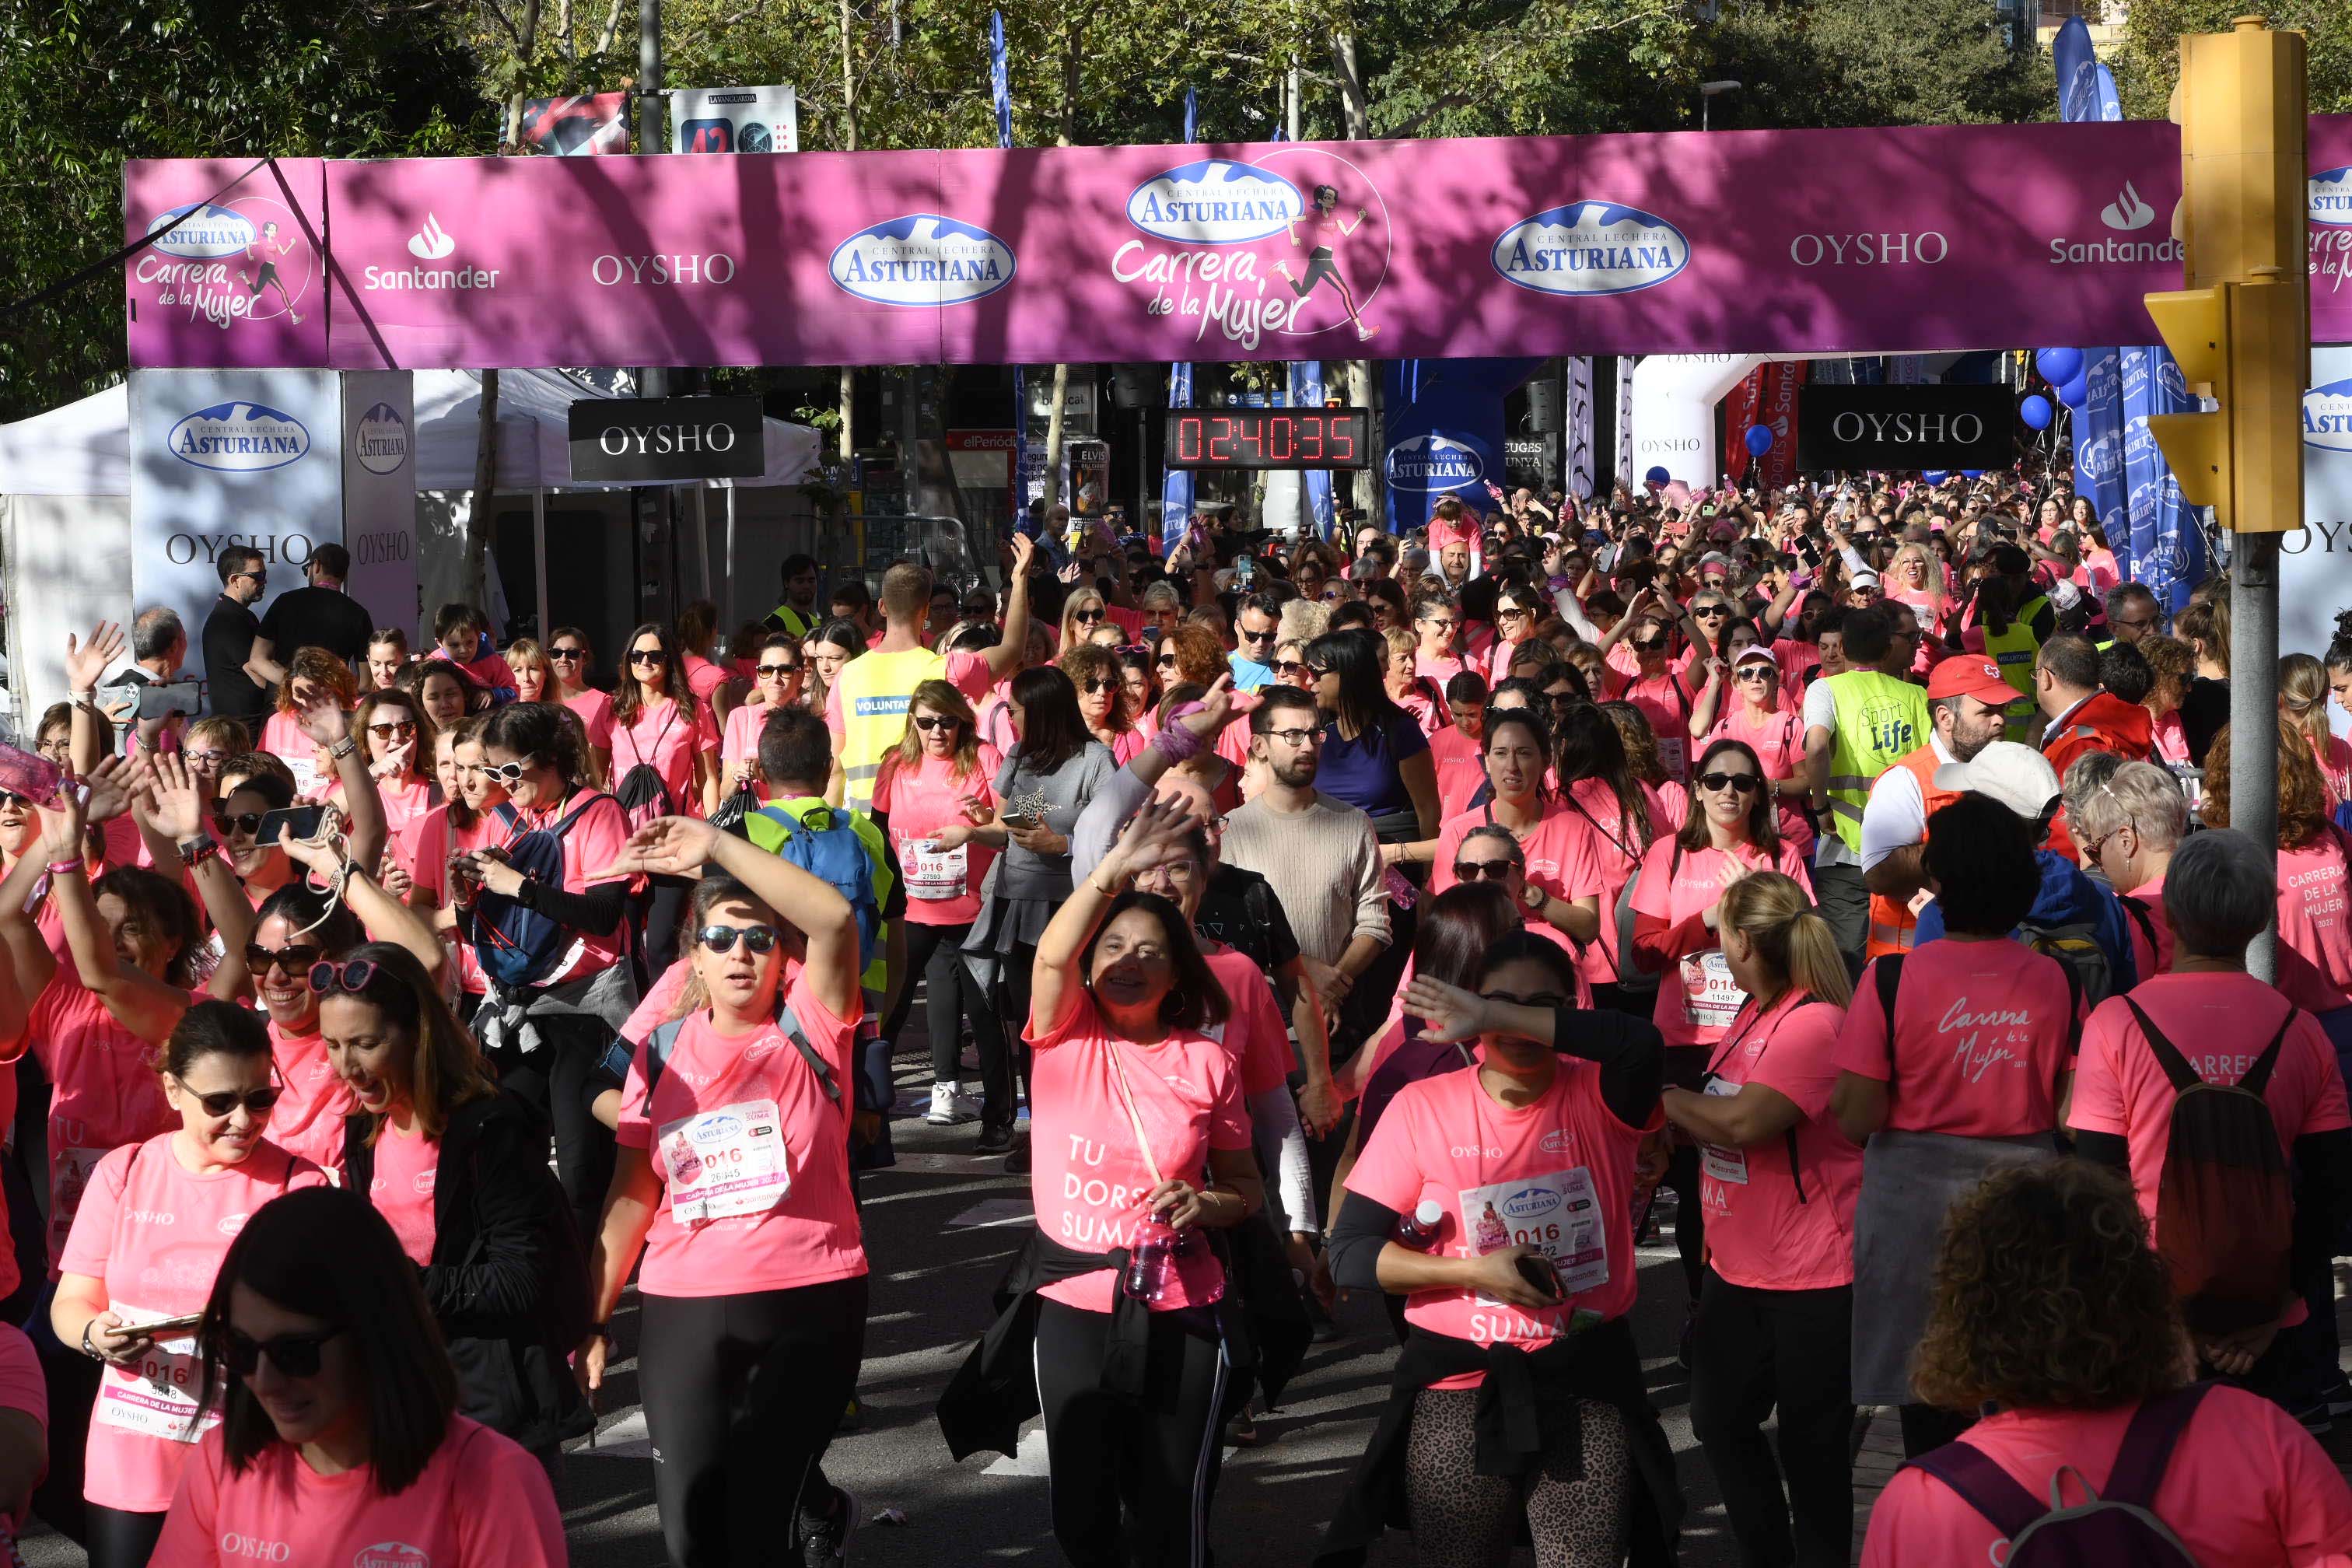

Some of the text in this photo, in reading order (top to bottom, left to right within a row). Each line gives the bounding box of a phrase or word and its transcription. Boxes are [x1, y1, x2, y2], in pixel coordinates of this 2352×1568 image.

[1140, 192, 1289, 222] ASTURIANA
[871, 245, 996, 254] CENTRAL LECHERA
[1537, 233, 1668, 243] CENTRAL LECHERA
[1790, 231, 1948, 266] OYSHO
[2049, 237, 2184, 264] Santande
[843, 249, 1002, 282] ASTURIANA
[1111, 240, 1257, 283] Carrera
[1507, 237, 1675, 271] ASTURIANA
[136, 255, 227, 284] Carrera
[364, 264, 499, 290] Santander
[591, 254, 735, 285] OYSHO
[159, 281, 262, 329] de la Mujer
[1147, 278, 1312, 350] de la Mujer
[1775, 360, 1796, 412] Santa
[600, 422, 735, 456] OYSHO
[1179, 417, 1354, 460] 02:40:35
[1832, 411, 1983, 444] OYSHO
[179, 429, 300, 454] ASTURIANA
[359, 430, 404, 457] ASTURIANA
[1081, 450, 1105, 460] ELVIS
[1641, 438, 1700, 453] OYSHO
[1389, 457, 1476, 479] ASTURIANA
[358, 530, 409, 565] OYSHO
[856, 700, 911, 712] VOLUNTAR
[1861, 702, 1903, 728] Sport
[1871, 719, 1913, 753] Life
[921, 863, 943, 872] 016
[2289, 865, 2344, 888] CARRERA
[2304, 882, 2340, 902] DE LA
[2304, 898, 2343, 919] MUJER
[1937, 996, 2033, 1033] Carrera
[1951, 1031, 2016, 1083] Mujer
[705, 1147, 742, 1168] 016
[1069, 1133, 1106, 1167] TU
[1063, 1171, 1146, 1210] DORS
[1563, 1183, 1585, 1195] SUMA
[1507, 1197, 1558, 1215] ASTURIANA
[1514, 1223, 1560, 1245] 016
[1469, 1312, 1567, 1342] SUMA
[145, 1360, 187, 1384] 016
[117, 1391, 150, 1405] CARRERA
[150, 1398, 160, 1408] DE
[160, 1401, 170, 1411] LA
[151, 1384, 177, 1399] 5848
[111, 1406, 149, 1424] OYSHO
[222, 1531, 290, 1563] OYSHO
